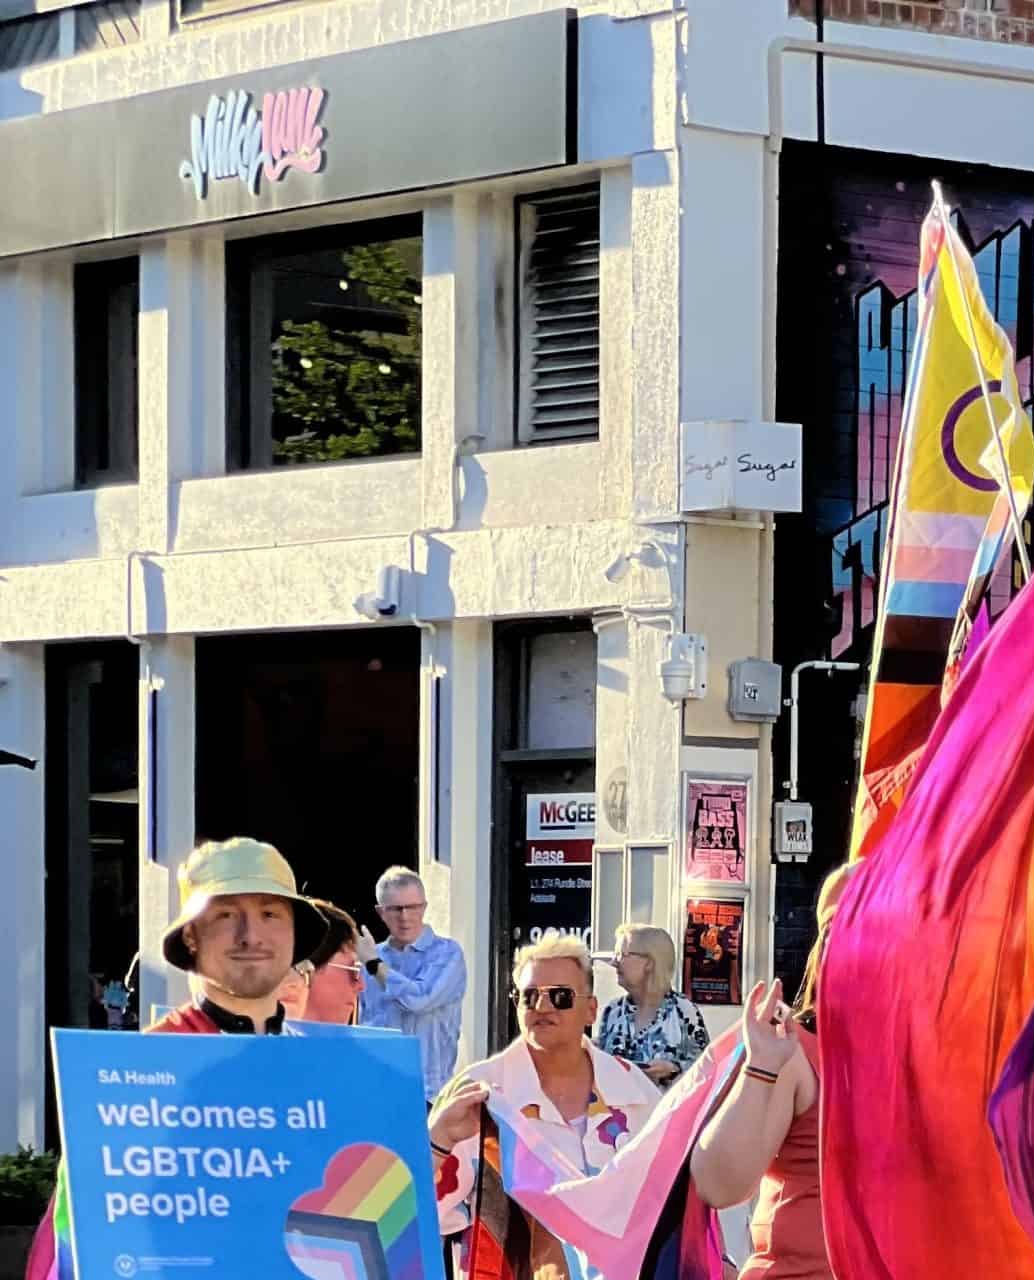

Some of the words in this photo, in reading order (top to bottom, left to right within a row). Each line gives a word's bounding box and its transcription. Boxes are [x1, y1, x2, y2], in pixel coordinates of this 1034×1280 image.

[737, 453, 796, 482] Sugar
[540, 800, 596, 824] McGEE
[531, 847, 565, 864] lease
[98, 1070, 121, 1084] SA
[125, 1071, 176, 1086] Health
[97, 1098, 277, 1129] welcomes
[287, 1100, 327, 1129] all
[101, 1146, 292, 1178] LGBTQIA+
[104, 1187, 230, 1224] people
